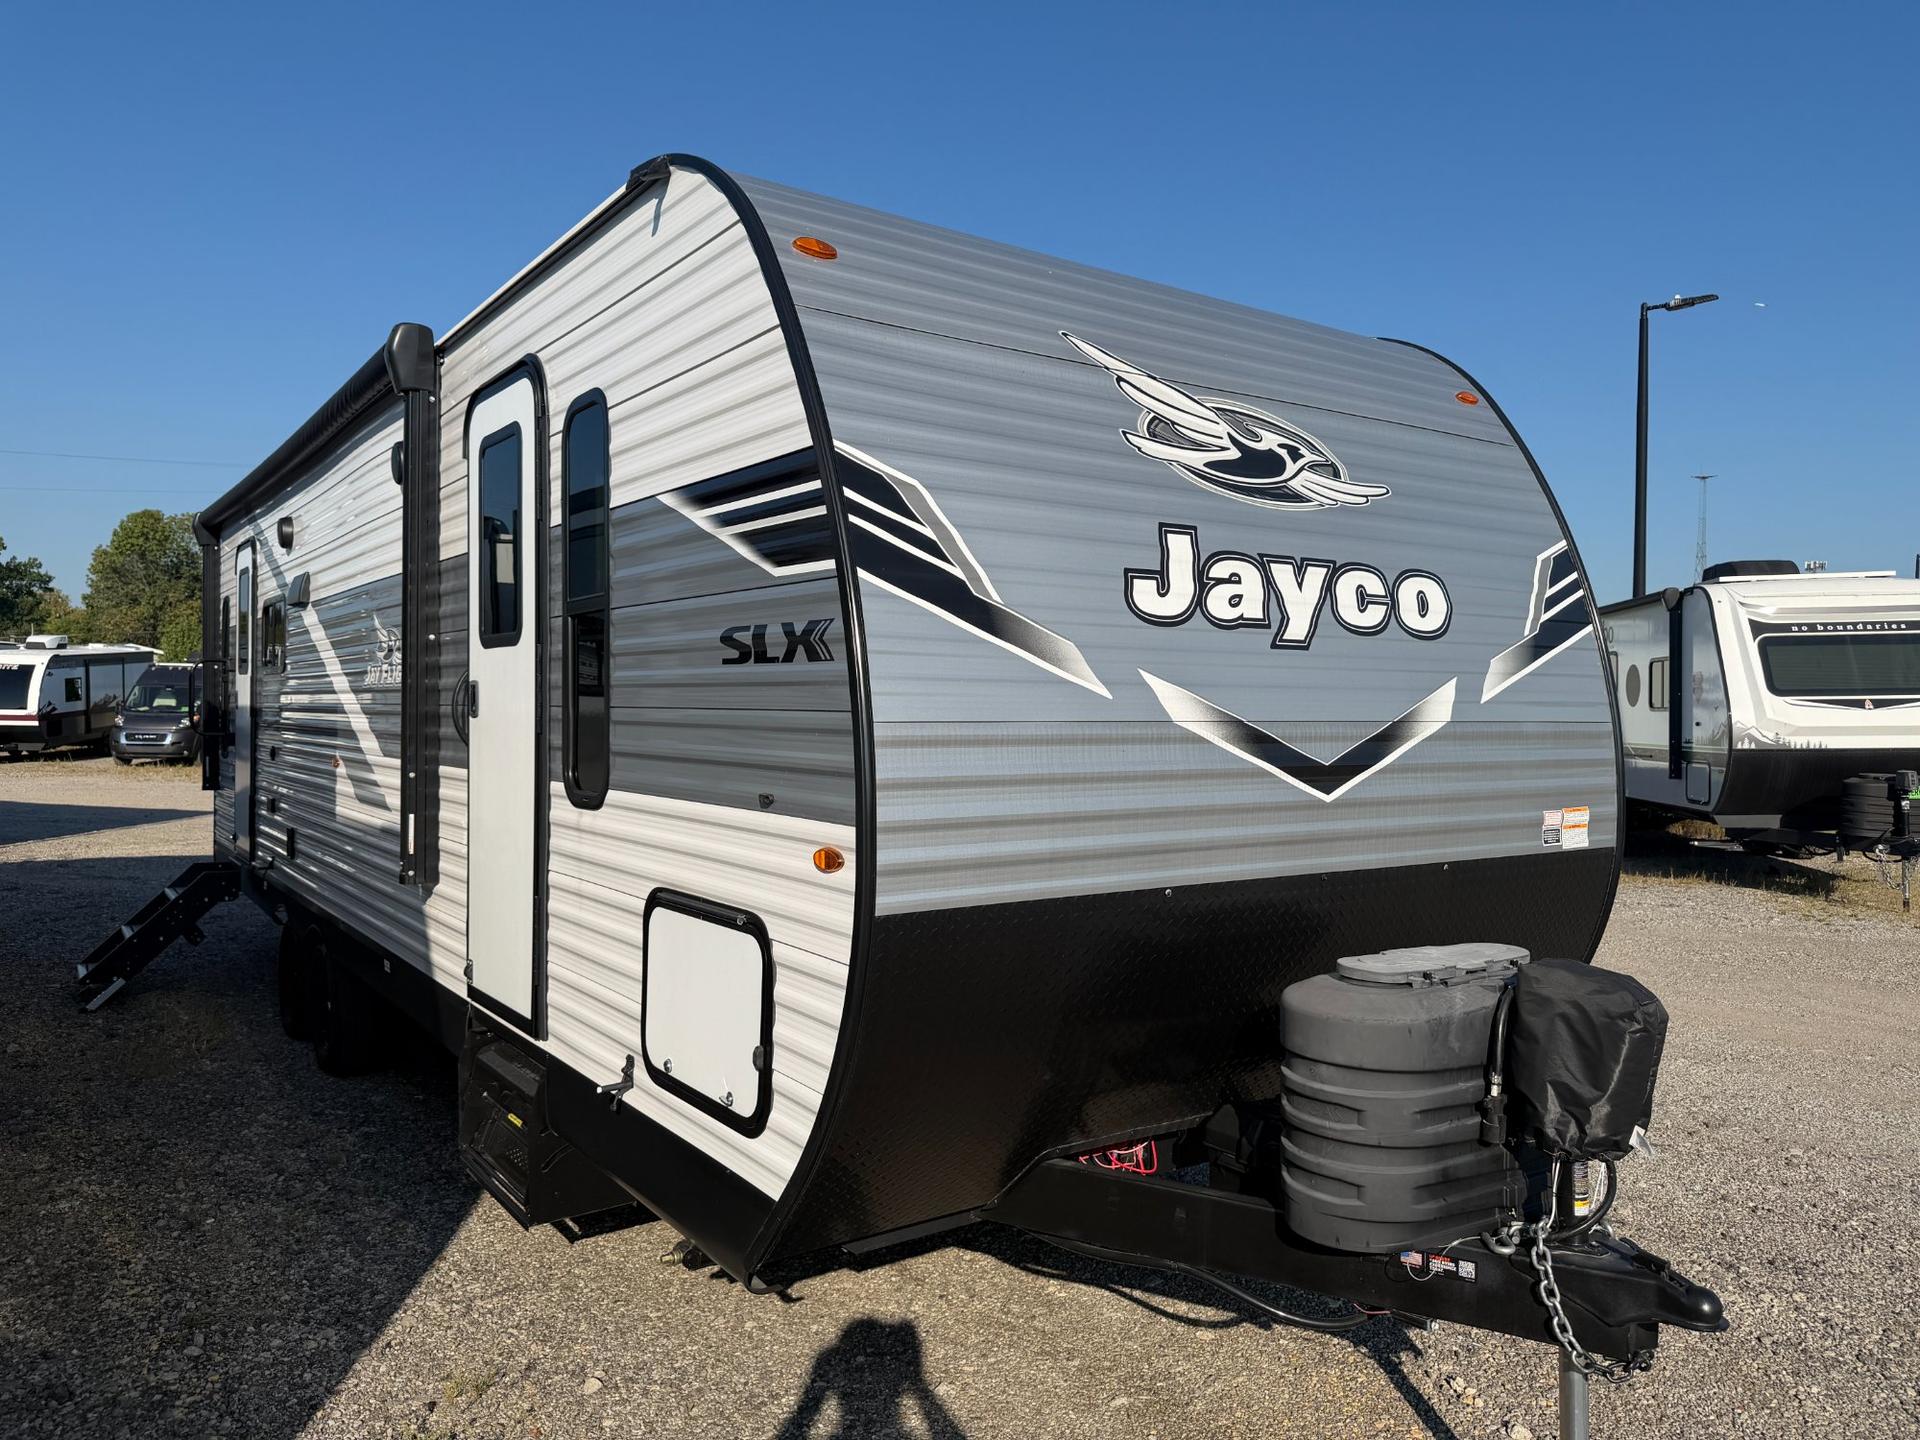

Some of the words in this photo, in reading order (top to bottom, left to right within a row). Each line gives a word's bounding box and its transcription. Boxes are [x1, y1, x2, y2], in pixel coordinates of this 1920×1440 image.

[1124, 522, 1453, 650] Jayco
[720, 618, 835, 665] SLX
[1816, 622, 1907, 631] boundaries
